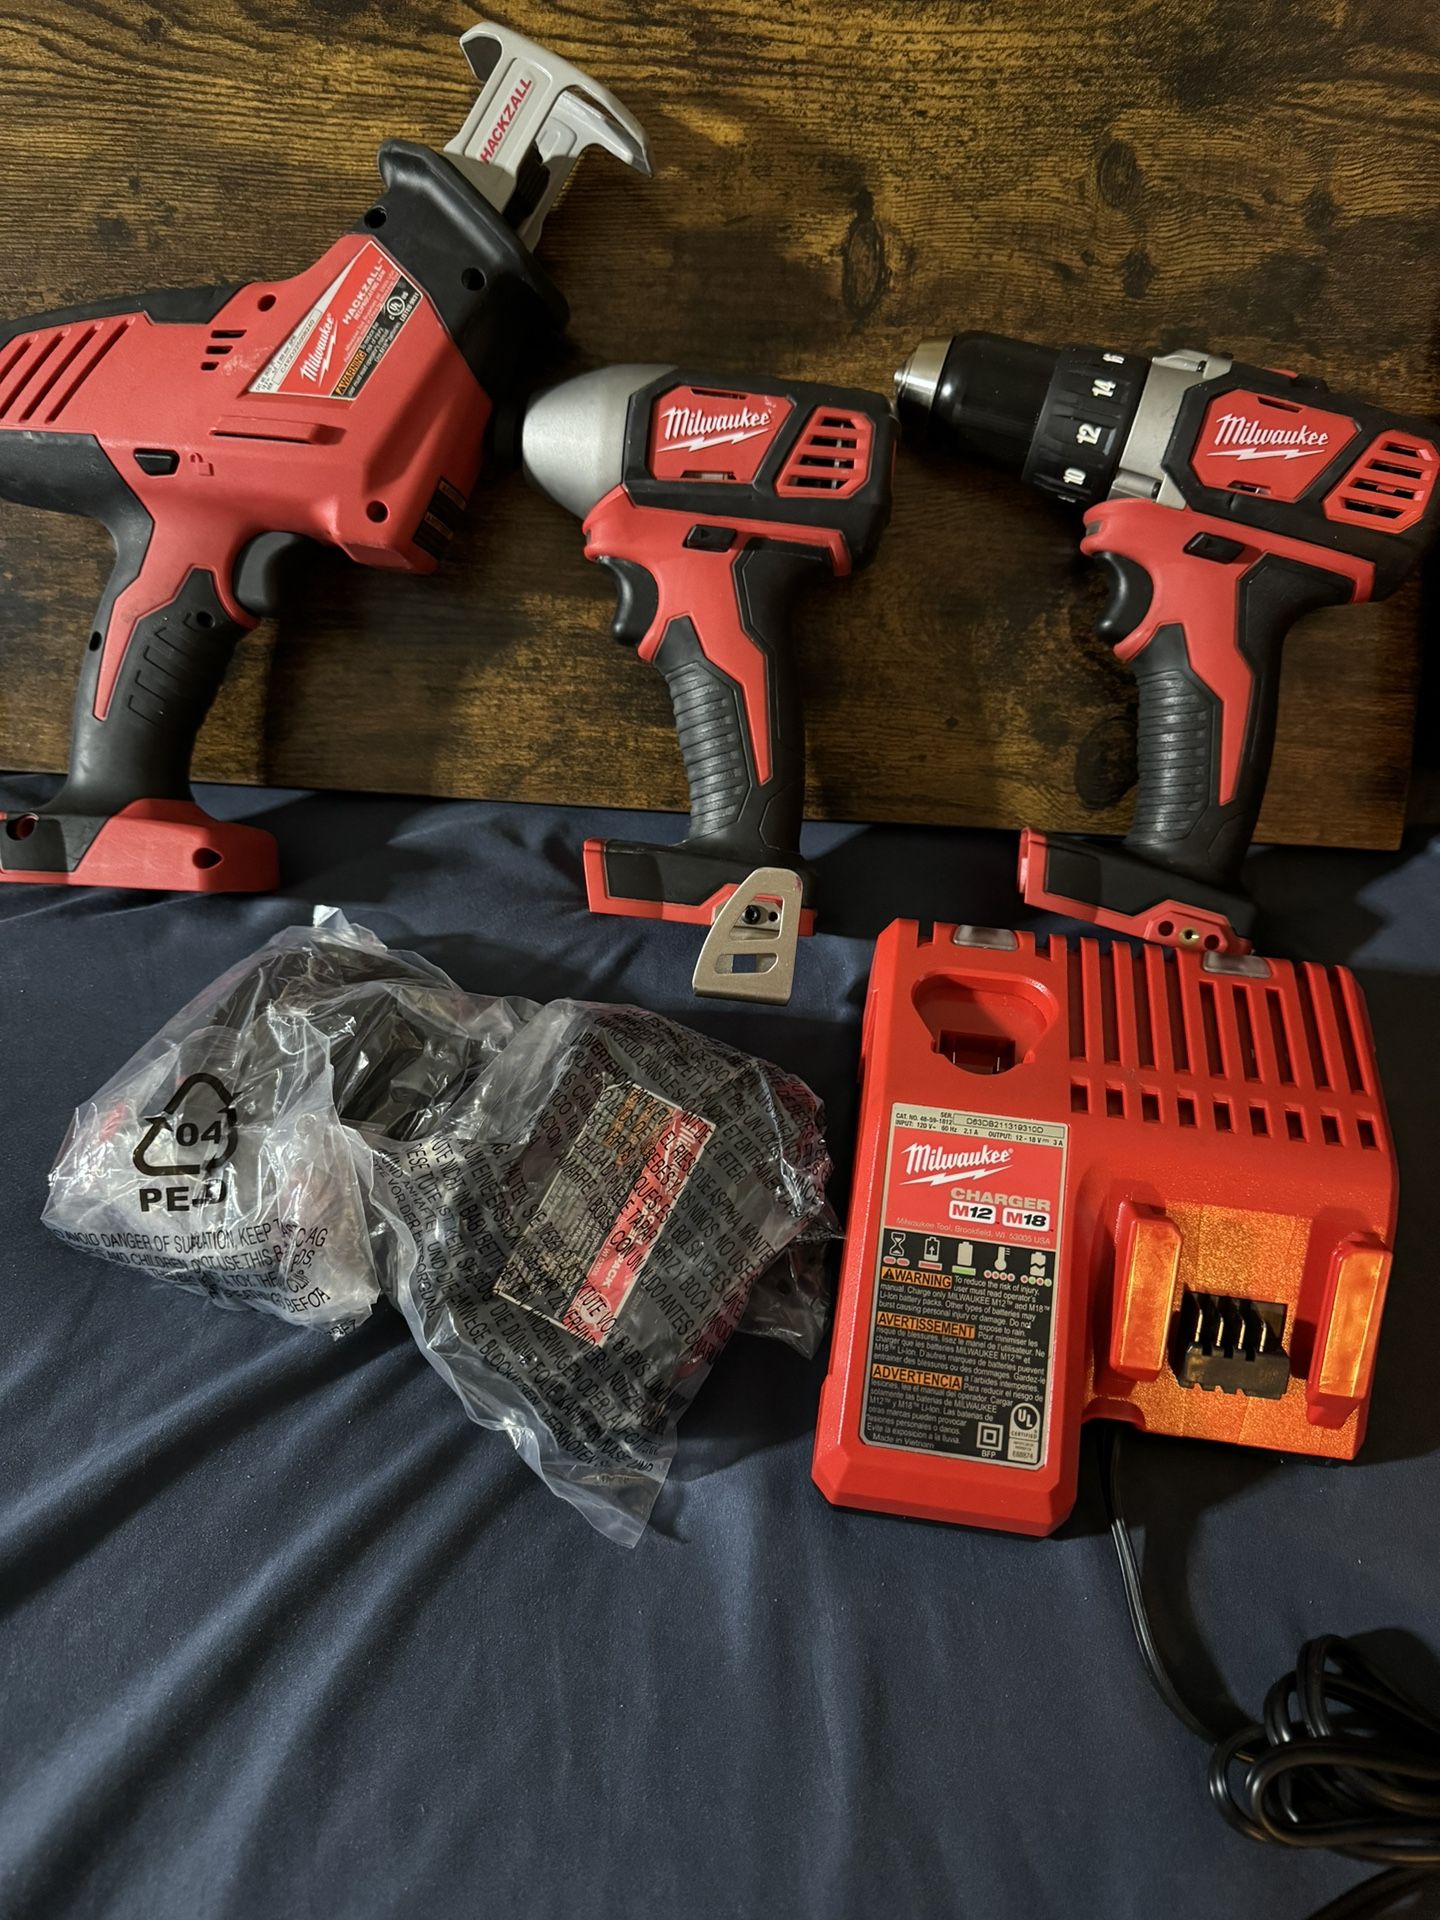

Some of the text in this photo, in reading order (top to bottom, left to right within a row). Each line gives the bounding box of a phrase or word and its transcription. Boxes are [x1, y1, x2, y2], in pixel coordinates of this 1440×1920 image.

[480, 77, 532, 164] HACKZALL
[341, 262, 383, 324] HACKZALL
[300, 314, 335, 383] Milwaukee
[339, 350, 366, 388] WARNING
[1091, 379, 1116, 397] 14
[660, 406, 771, 440] Milwaukee
[1076, 423, 1101, 444] 12
[1214, 413, 1329, 446] Milwaukee
[1063, 467, 1086, 485] 10
[175, 1121, 222, 1147] 04
[894, 1118, 914, 1127] INPUT:
[916, 1121, 927, 1129] 120
[987, 1130, 1013, 1140] OUTPUT:
[901, 1142, 1011, 1176] Milwaukee
[469, 1163, 500, 1196] EINE
[696, 1174, 716, 1194] DE
[385, 1178, 406, 1203] VOR
[399, 1205, 420, 1229] DER
[451, 1188, 474, 1209] IN
[949, 1186, 1051, 1212] CHARGER
[951, 1203, 1047, 1227] M12 M18
[99, 1228, 154, 1253] DANGER
[152, 1234, 170, 1253] OF
[237, 1219, 272, 1246] KEEP
[896, 1216, 934, 1229] Milwaukee
[1032, 1234, 1050, 1244] USA
[414, 1168, 448, 1204] TÜTE
[489, 1303, 514, 1327] DIE
[670, 1225, 704, 1261] BOLSA
[712, 1233, 735, 1257] NO
[421, 1241, 450, 1271] UND
[494, 1159, 534, 1206] HALTEN
[521, 1203, 547, 1227] SIE
[612, 1335, 651, 1380] BABYS
[893, 1270, 952, 1288] WARNING
[608, 1229, 636, 1258] CON
[634, 1265, 666, 1298] NUDO
[654, 1292, 695, 1336] ANTES
[678, 1276, 713, 1313] BOCA
[953, 1285, 968, 1293] user
[968, 1287, 985, 1296] must
[986, 1289, 1002, 1298] read
[954, 1275, 1019, 1292] To reduce the risk of
[898, 1294, 921, 1305] battery
[944, 1300, 963, 1309] Other
[964, 1303, 982, 1314] types
[983, 1306, 991, 1314] of
[991, 1307, 1020, 1318] batteries
[1020, 1313, 1036, 1322] may
[906, 1286, 931, 1297] Charge
[947, 1292, 990, 1304] MILWAUKEE
[1014, 1302, 1027, 1310] and
[877, 1312, 973, 1337] AVERTISSEMENT
[878, 1300, 895, 1309] burst
[895, 1302, 921, 1314] causing
[922, 1306, 951, 1318] personal
[970, 1313, 979, 1321] or
[1008, 1318, 1019, 1327] Do
[977, 1332, 993, 1340] Pour
[1027, 1339, 1038, 1347] les
[978, 1324, 1002, 1333] expose
[955, 1346, 998, 1359] MILWAUKEE
[977, 1358, 986, 1366] de
[872, 1365, 962, 1389] ADVERTENCIA
[963, 1383, 979, 1392] Para
[1004, 1389, 1012, 1397] el
[1034, 1394, 1043, 1402] de
[989, 1396, 1013, 1407] Cargar
[953, 1400, 997, 1413] MILWAUKEE
[1018, 1409, 1033, 1428] UL
[937, 1416, 966, 1428] provocar
[872, 1433, 934, 1448] Made in Vietnam
[980, 1449, 995, 1458] BFP
